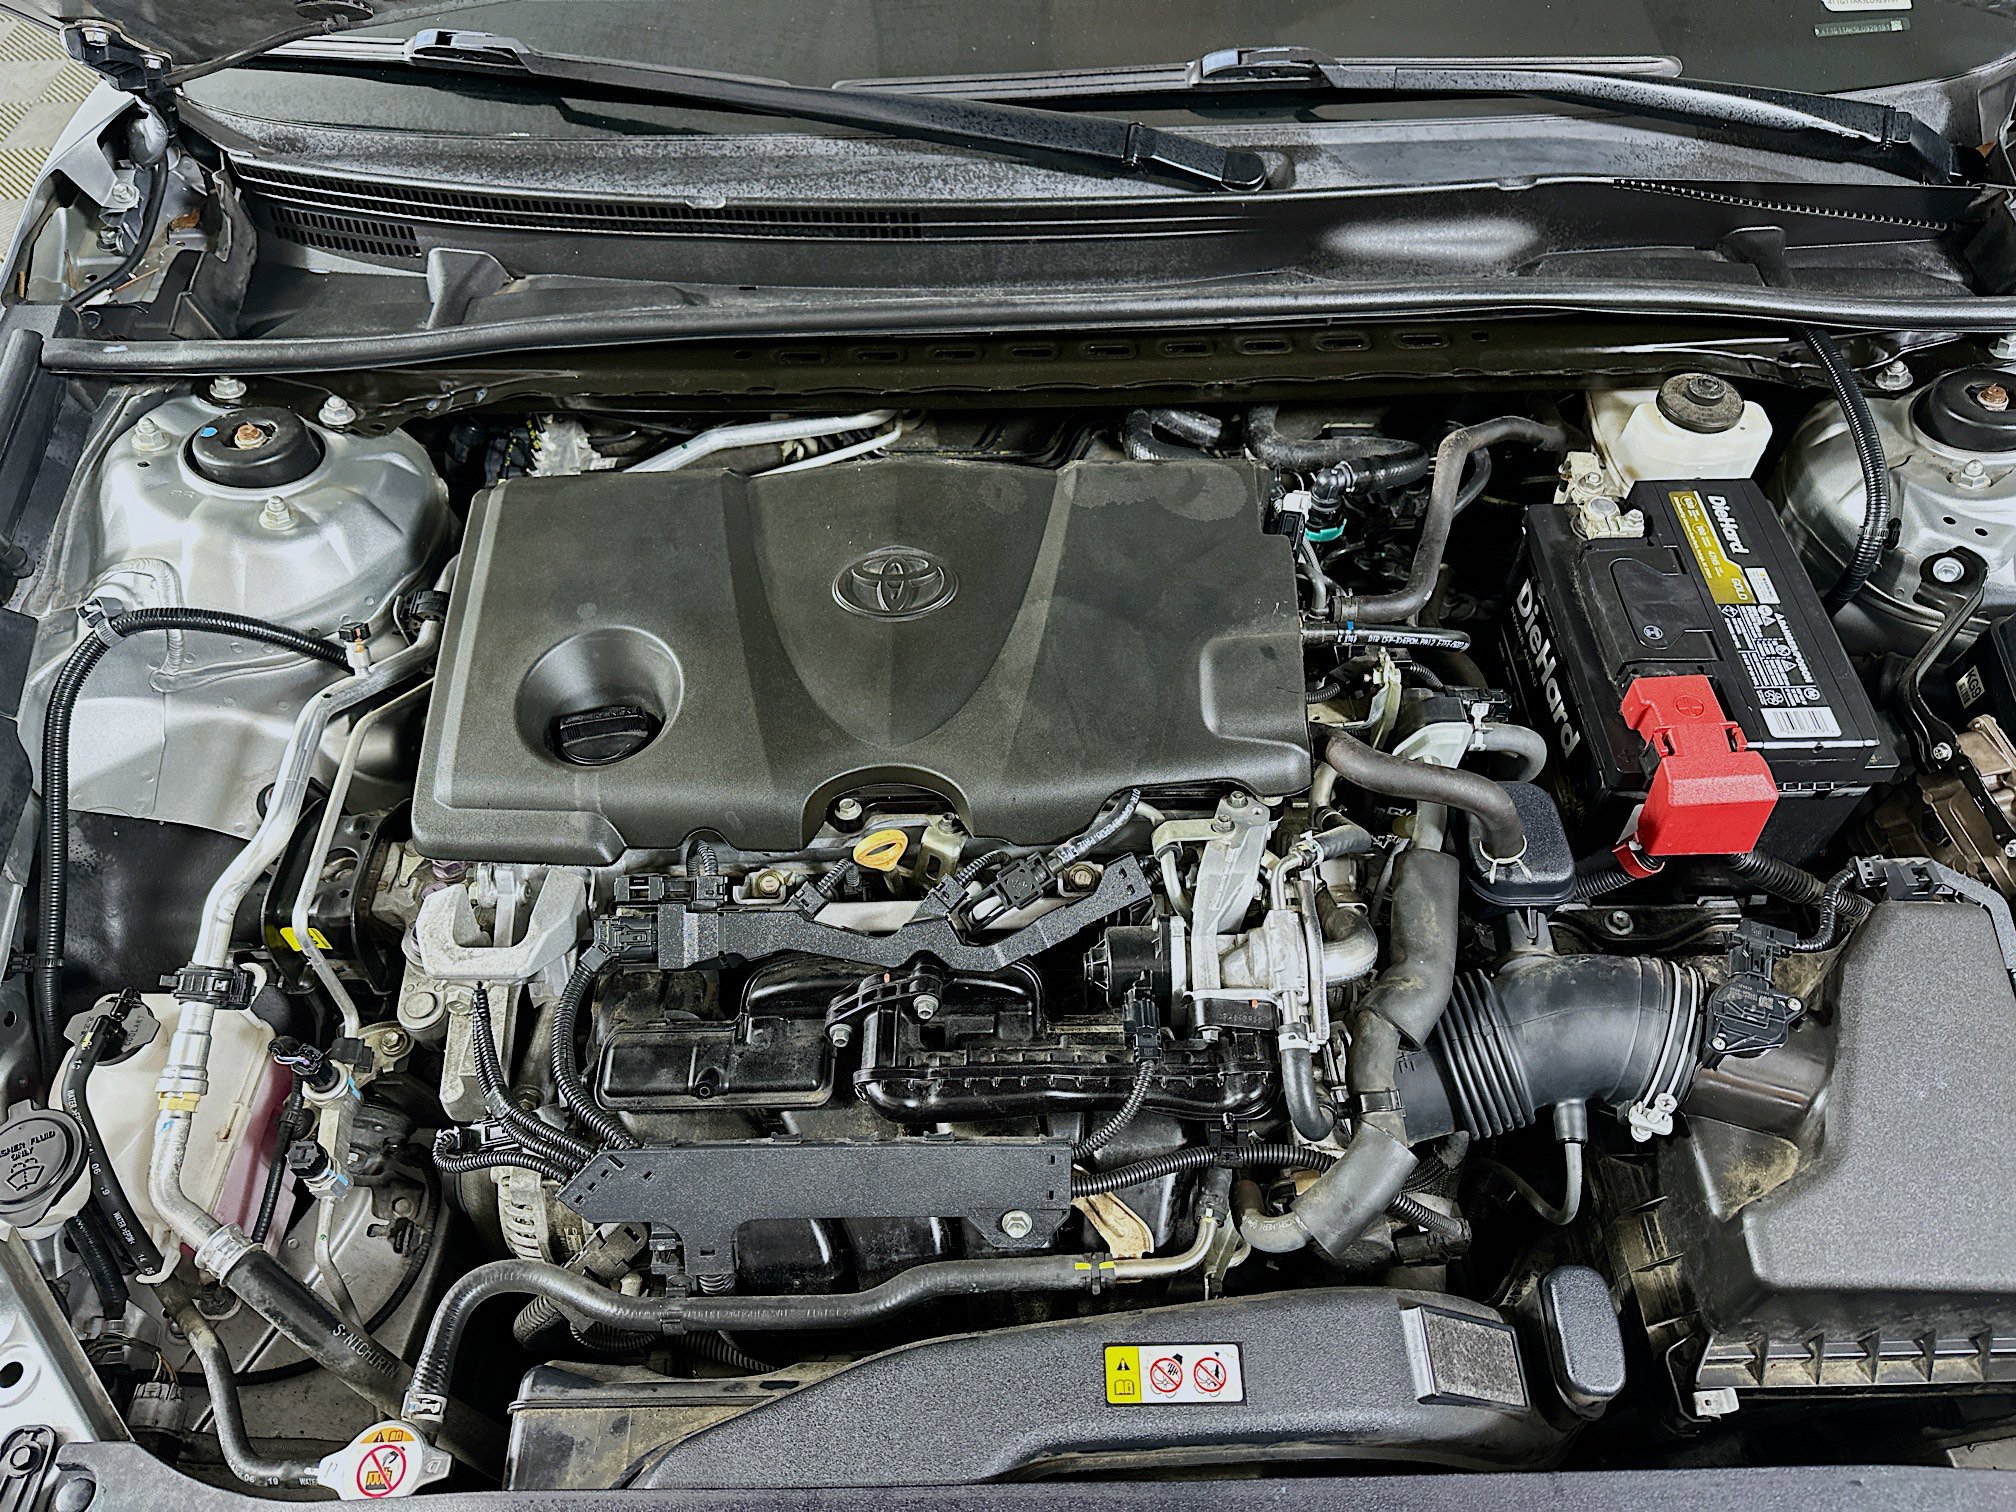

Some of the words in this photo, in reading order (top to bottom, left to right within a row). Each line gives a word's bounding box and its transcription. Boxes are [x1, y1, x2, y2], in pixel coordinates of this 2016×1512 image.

[1708, 495, 1750, 554] DieHard
[1730, 577, 1749, 600] GOLD
[1511, 606, 1525, 646] POWER
[1516, 577, 1581, 759] DieHard
[1964, 669, 1984, 698] KG9
[66, 1088, 77, 1111] WATER
[30, 1130, 57, 1146] FLUID
[10, 1146, 35, 1162] ONLY
[267, 1477, 280, 1486] 19
